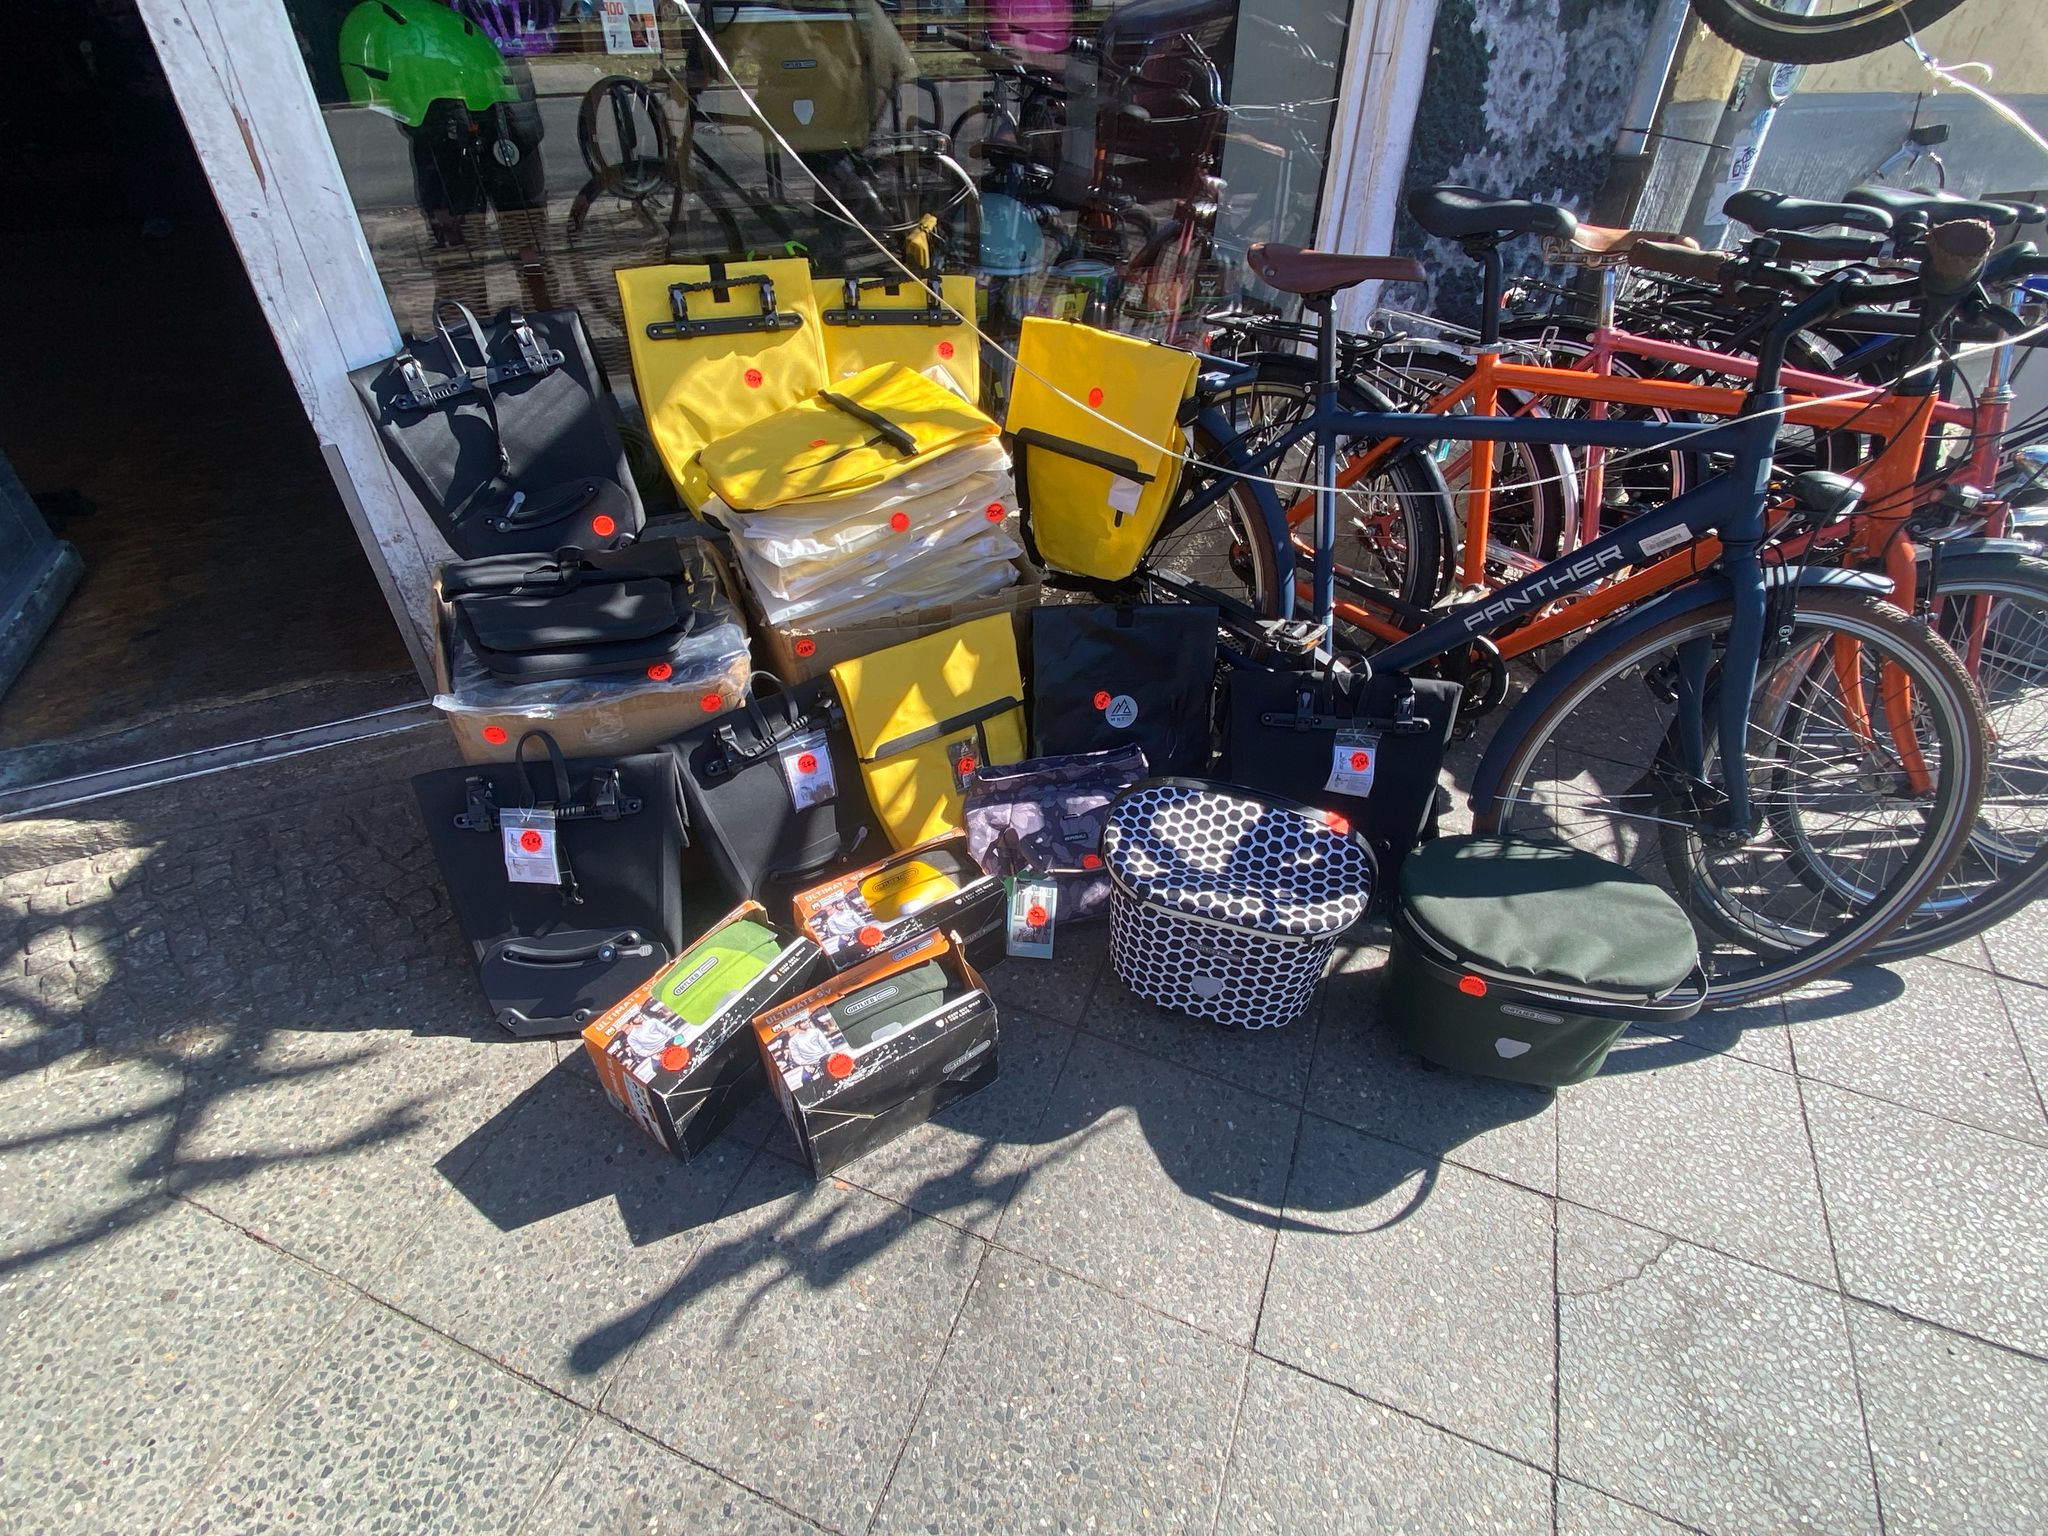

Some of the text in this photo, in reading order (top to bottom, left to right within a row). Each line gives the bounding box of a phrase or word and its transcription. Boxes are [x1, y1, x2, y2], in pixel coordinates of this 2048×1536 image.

[1463, 544, 1625, 631] PANTHER
[805, 879, 848, 902] ULTIMATE
[595, 988, 641, 1032] ULTIMATE
[765, 996, 815, 1025] ULTIMATE
[848, 997, 876, 1013] ORTLIEB
